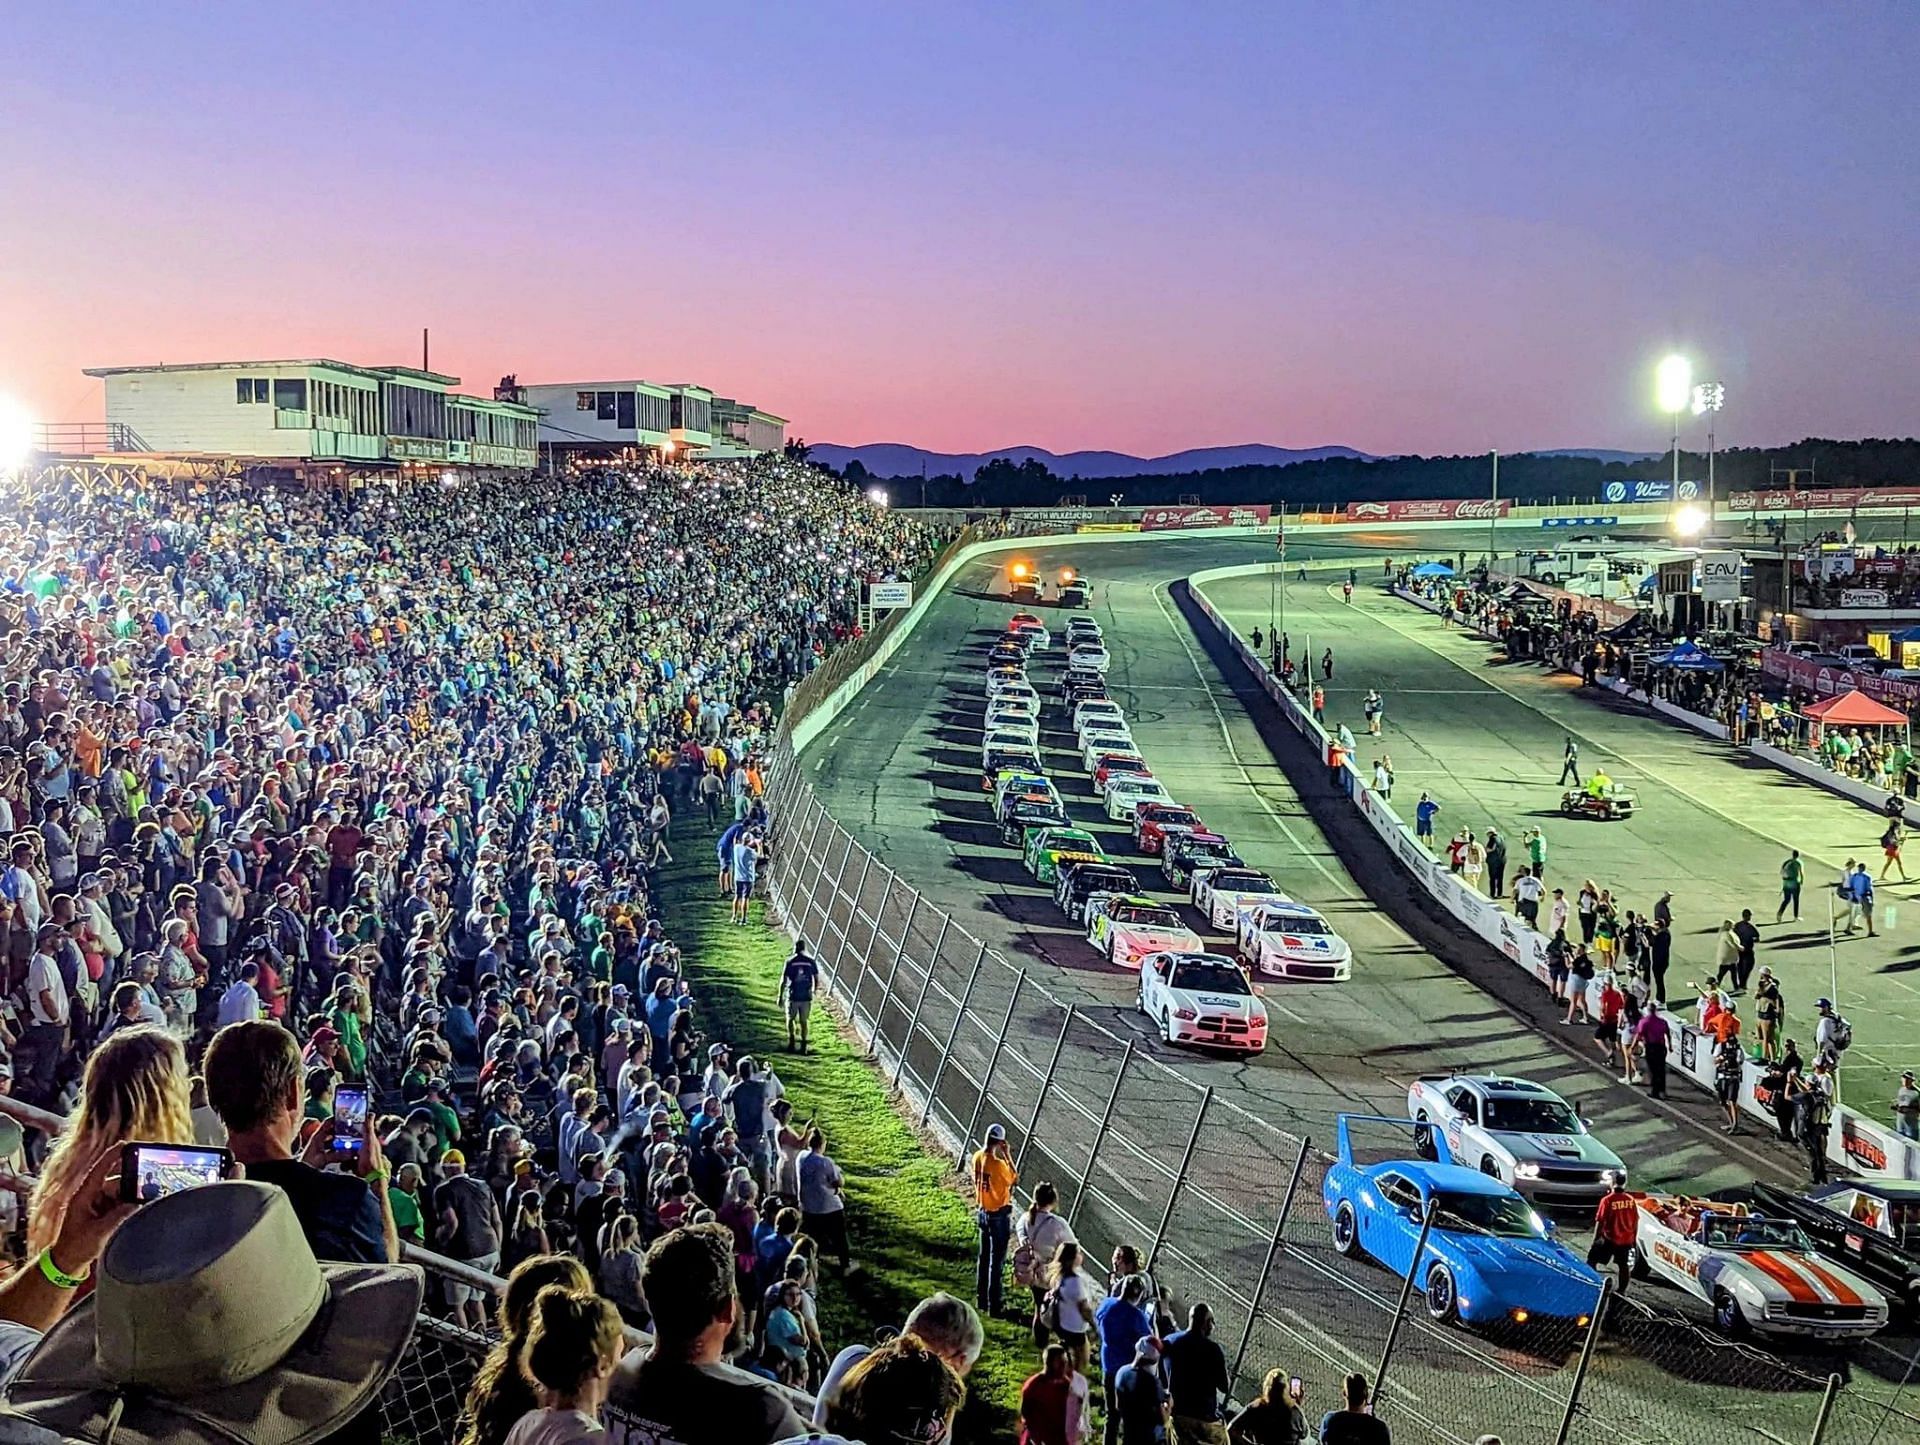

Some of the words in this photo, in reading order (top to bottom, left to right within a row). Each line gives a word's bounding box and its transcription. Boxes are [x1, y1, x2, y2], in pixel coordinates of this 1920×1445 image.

[1764, 493, 1791, 506] BUSCH
[1023, 512, 1048, 520] NORTH
[1704, 564, 1738, 575] EAV
[1861, 676, 1882, 690] FREE
[1611, 1200, 1635, 1210] STAFF
